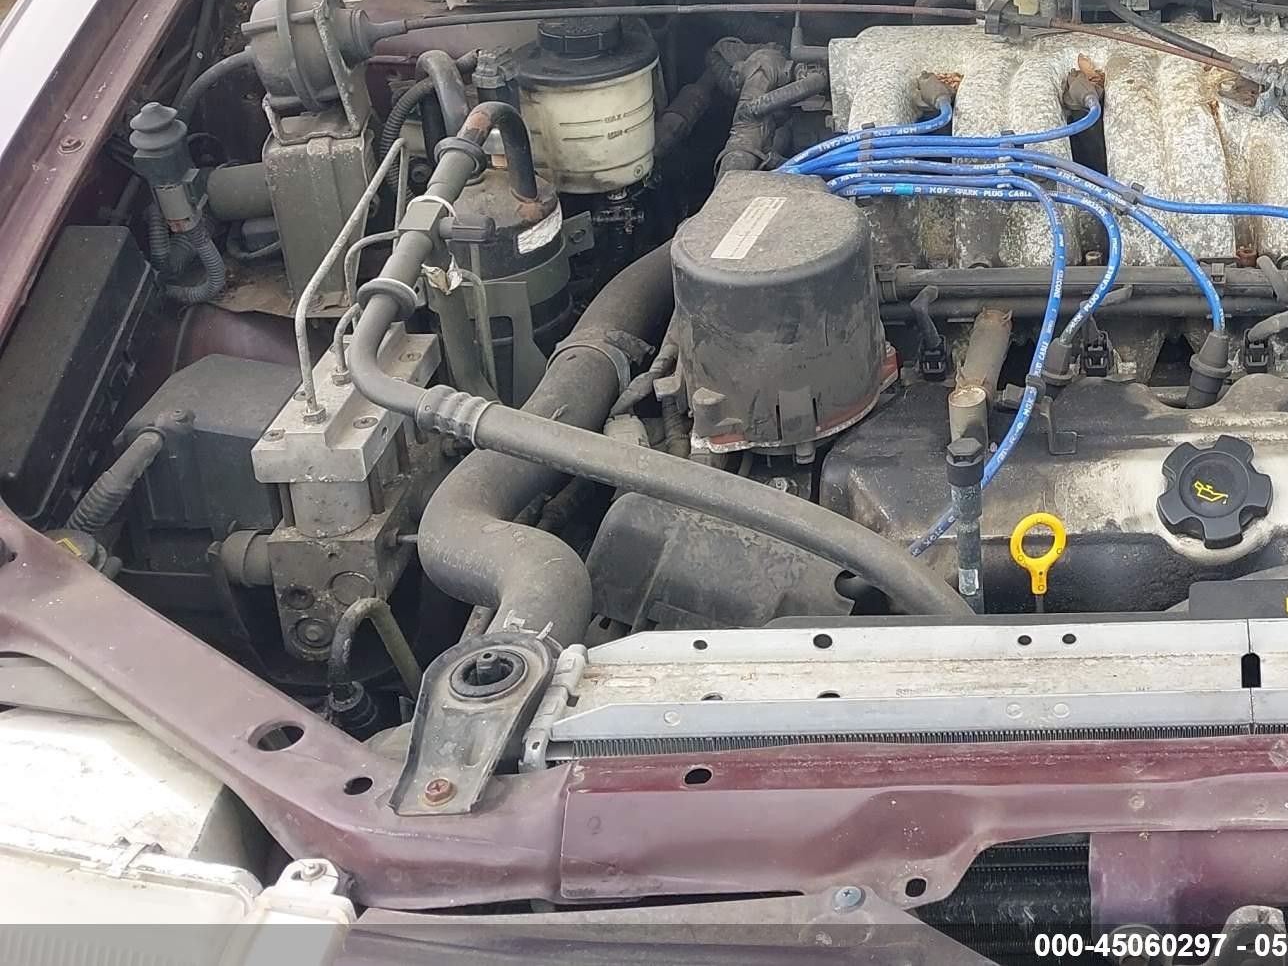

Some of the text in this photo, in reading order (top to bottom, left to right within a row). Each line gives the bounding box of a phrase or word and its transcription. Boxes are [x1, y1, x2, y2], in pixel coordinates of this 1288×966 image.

[954, 187, 978, 197] SPARK
[983, 189, 1004, 198] PLUG
[1007, 190, 1033, 198] CABLE
[1084, 293, 1100, 312] PLUG
[1099, 265, 1116, 291] CABLE
